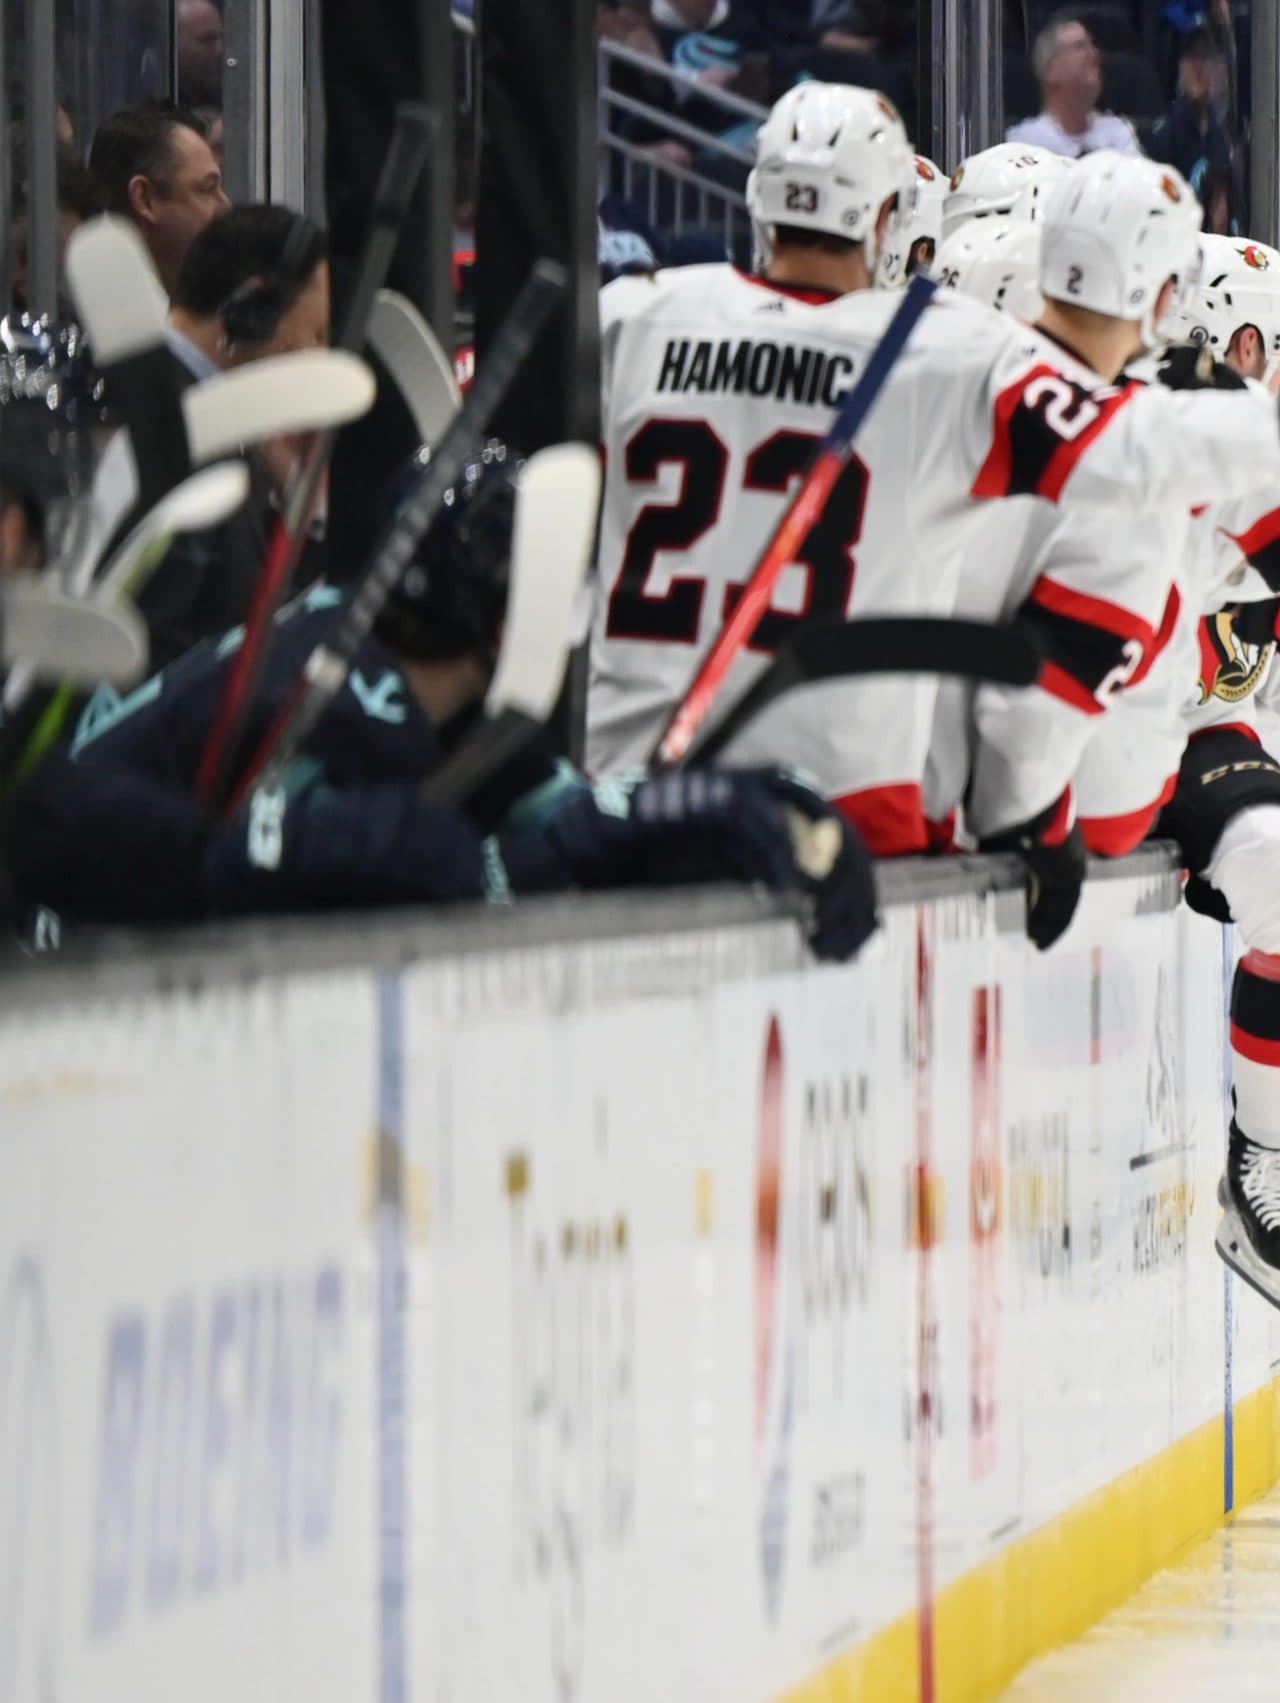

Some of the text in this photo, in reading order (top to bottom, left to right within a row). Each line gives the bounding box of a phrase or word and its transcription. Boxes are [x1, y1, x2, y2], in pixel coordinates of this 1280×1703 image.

[784, 181, 818, 214] 23
[1067, 265, 1083, 294] 2
[657, 339, 854, 408] HAMONIC
[605, 415, 872, 663] 23
